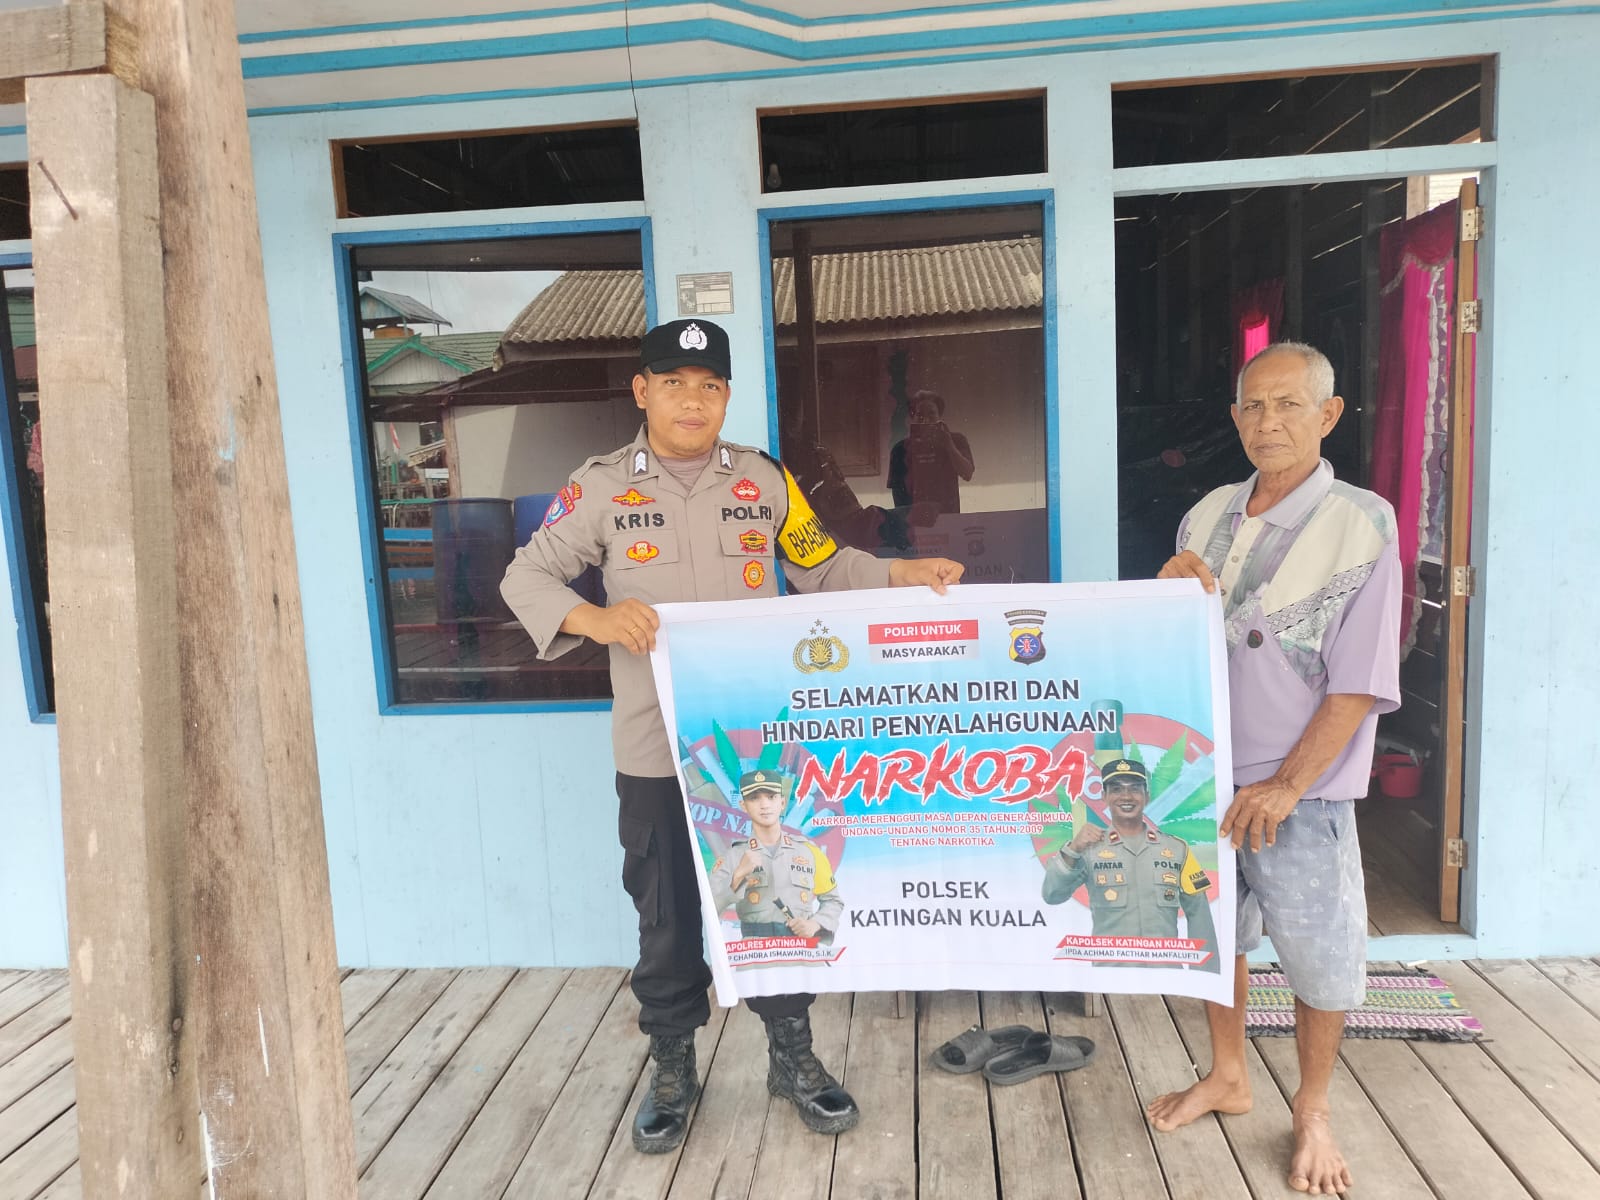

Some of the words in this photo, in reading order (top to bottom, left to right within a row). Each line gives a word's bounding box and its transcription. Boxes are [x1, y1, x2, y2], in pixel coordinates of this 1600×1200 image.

[721, 505, 772, 521] POLRI
[614, 512, 665, 530] KRIS
[884, 626, 918, 637] POLRI
[920, 624, 962, 635] UNTUK
[882, 645, 966, 658] MASYARAKAT
[792, 683, 958, 710] SELAMATKAN
[967, 681, 1017, 700] DIRI
[1026, 679, 1079, 700] DAN
[763, 717, 862, 743] HINDARI
[872, 711, 1116, 737] PENYALAHGUNAAN
[796, 740, 1087, 806] NARKOBA
[812, 816, 859, 826] NARKOBA
[862, 813, 921, 824] MERENGGUT
[924, 813, 952, 822] MASA
[955, 812, 988, 822] DEPAN
[990, 812, 1041, 822] GENERASI
[1043, 812, 1074, 822] MUDA
[842, 826, 929, 836] UNDANG-UNDANG
[931, 825, 967, 834] NOMOR
[969, 825, 981, 834] 35
[984, 825, 1017, 834] TAHUN
[1019, 825, 1044, 834] 2009
[891, 837, 936, 848] TENTANG
[938, 837, 995, 846] NARKOTIKA
[902, 881, 990, 898] POLSEK
[851, 909, 963, 927] KATINGAN
[970, 909, 1048, 927] KUALA
[726, 940, 763, 953] APOLRES
[765, 938, 807, 949] KATINGAN
[1066, 936, 1114, 947] KAPOLSEK
[1115, 938, 1163, 948] KATINGAN
[1164, 939, 1196, 949] KUALA
[733, 951, 769, 962] CHANDRA
[1083, 949, 1115, 957] ACHMAD
[1116, 950, 1150, 958] FACTHAR
